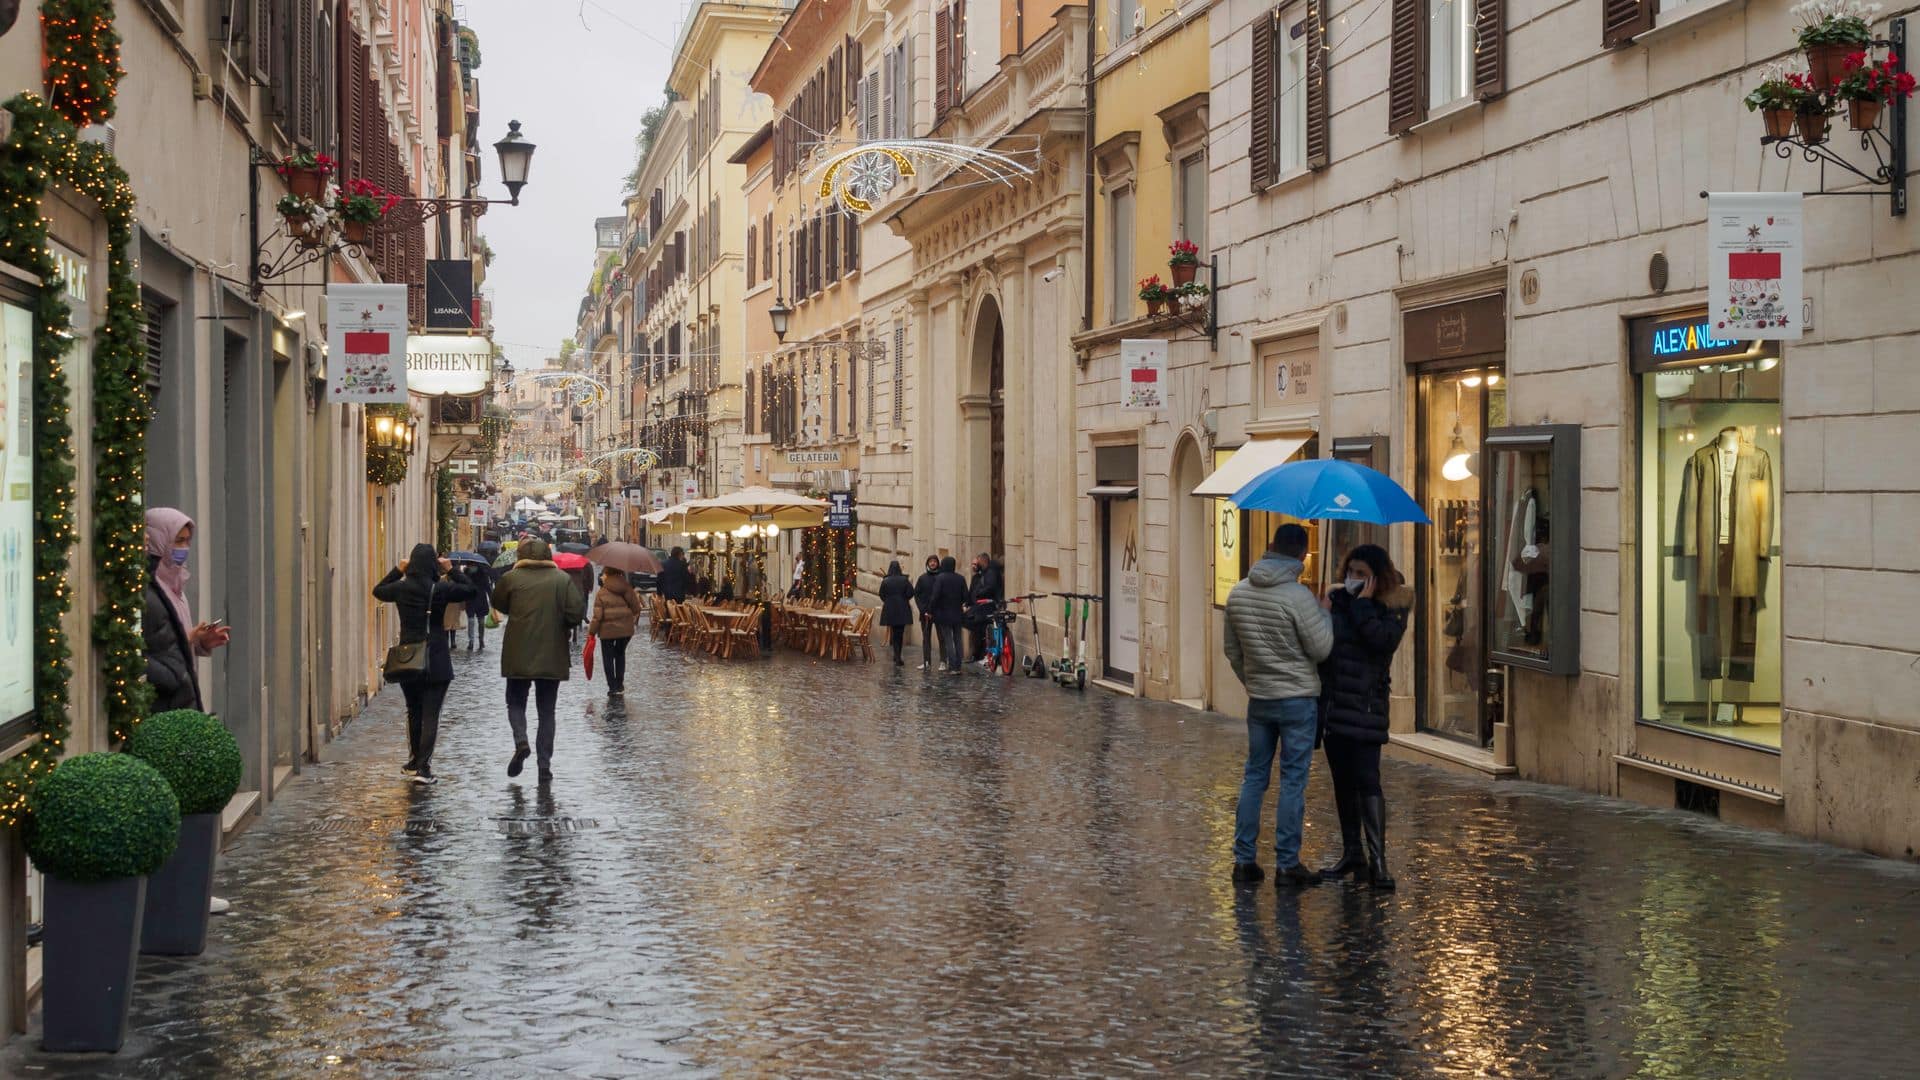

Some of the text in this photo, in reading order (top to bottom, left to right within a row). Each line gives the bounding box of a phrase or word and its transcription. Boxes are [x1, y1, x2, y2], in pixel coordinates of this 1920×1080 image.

[434, 307, 464, 315] LISANZA
[406, 352, 491, 371] BRIGHENTI
[789, 453, 839, 463] GELATERIA
